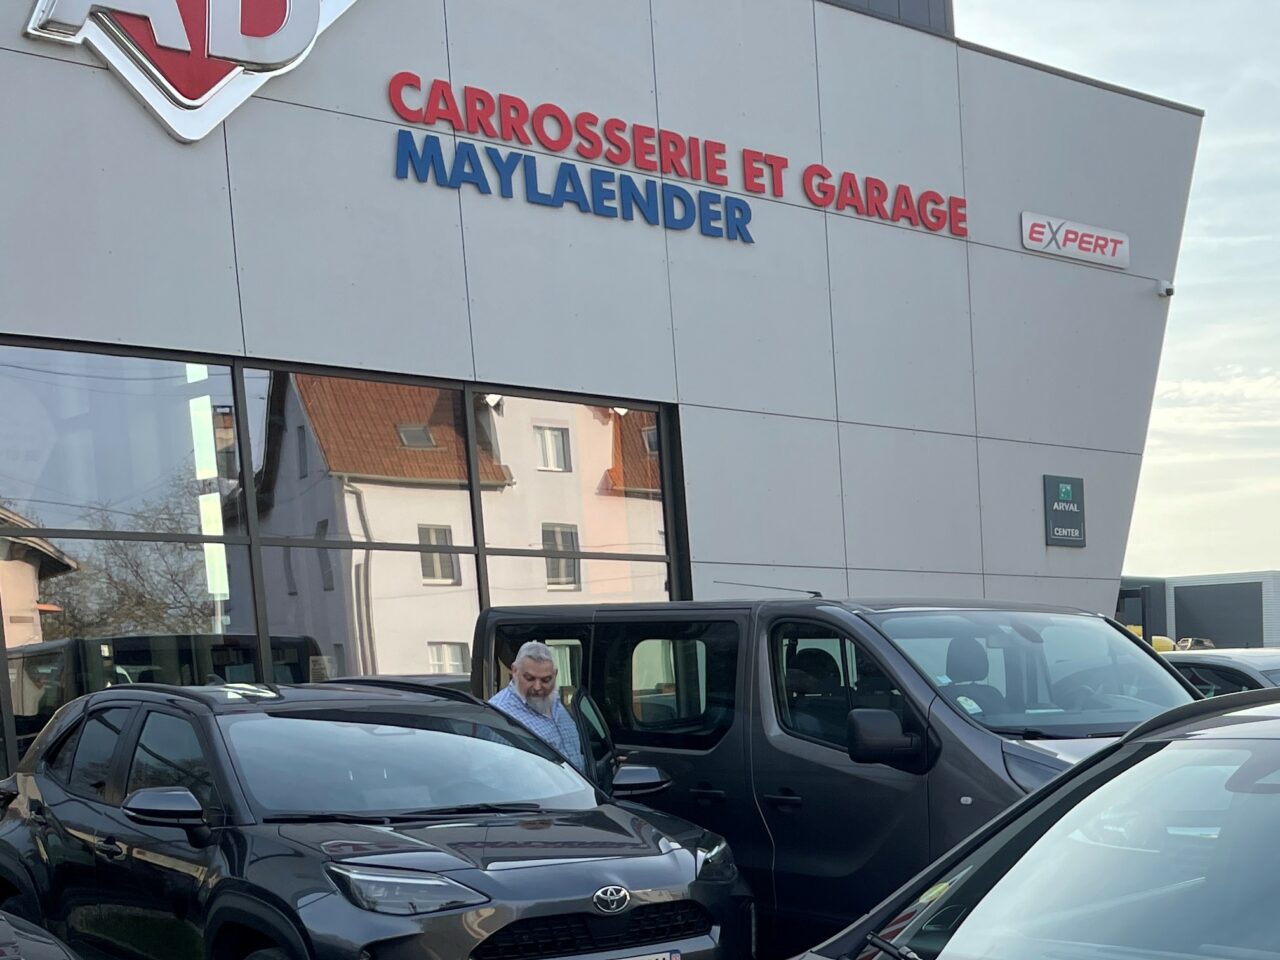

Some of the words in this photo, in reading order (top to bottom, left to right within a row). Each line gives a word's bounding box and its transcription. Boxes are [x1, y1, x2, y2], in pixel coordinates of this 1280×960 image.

[389, 71, 728, 187] CARROSSERIE
[742, 148, 788, 198] ET
[802, 163, 968, 237] GARAGE
[395, 128, 755, 244] MAYLAENDER
[1028, 220, 1124, 257] EXPERT
[1053, 502, 1080, 512] ARVAL
[1054, 527, 1080, 537] CENTER
